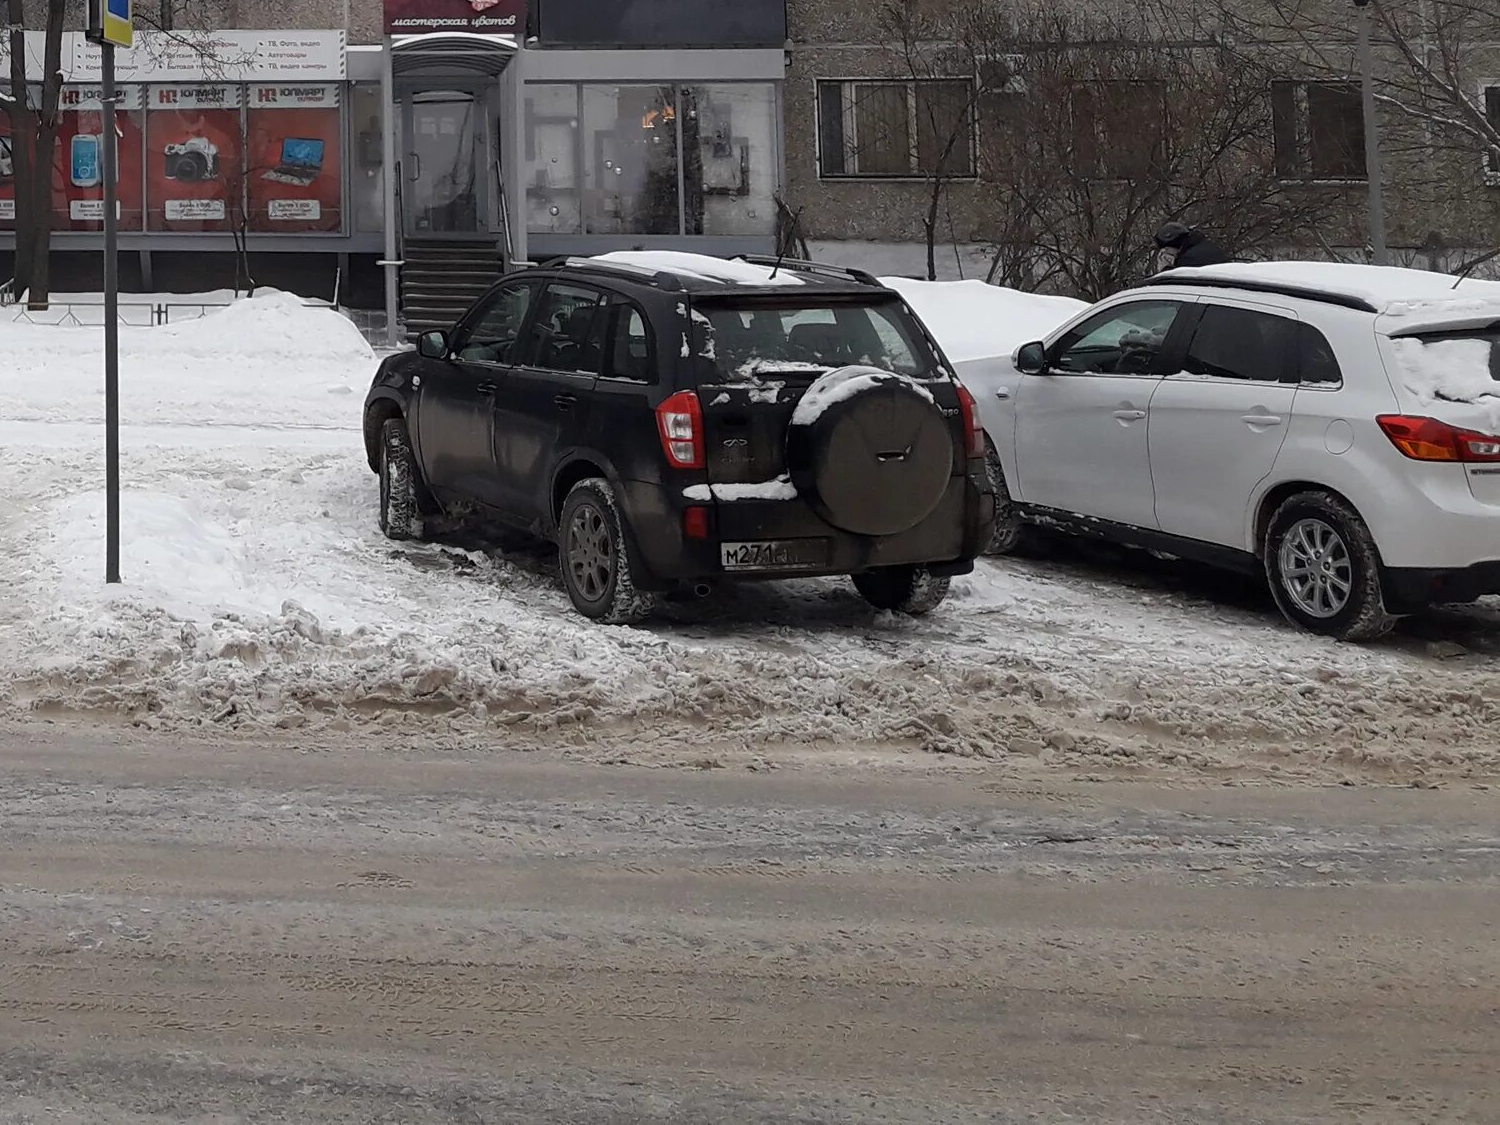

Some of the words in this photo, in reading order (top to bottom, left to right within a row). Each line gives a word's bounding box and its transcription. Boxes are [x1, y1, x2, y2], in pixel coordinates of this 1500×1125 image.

[392, 17, 468, 28] мастерская
[471, 15, 516, 27] цветов
[280, 87, 326, 97] ЮЛМАРТ
